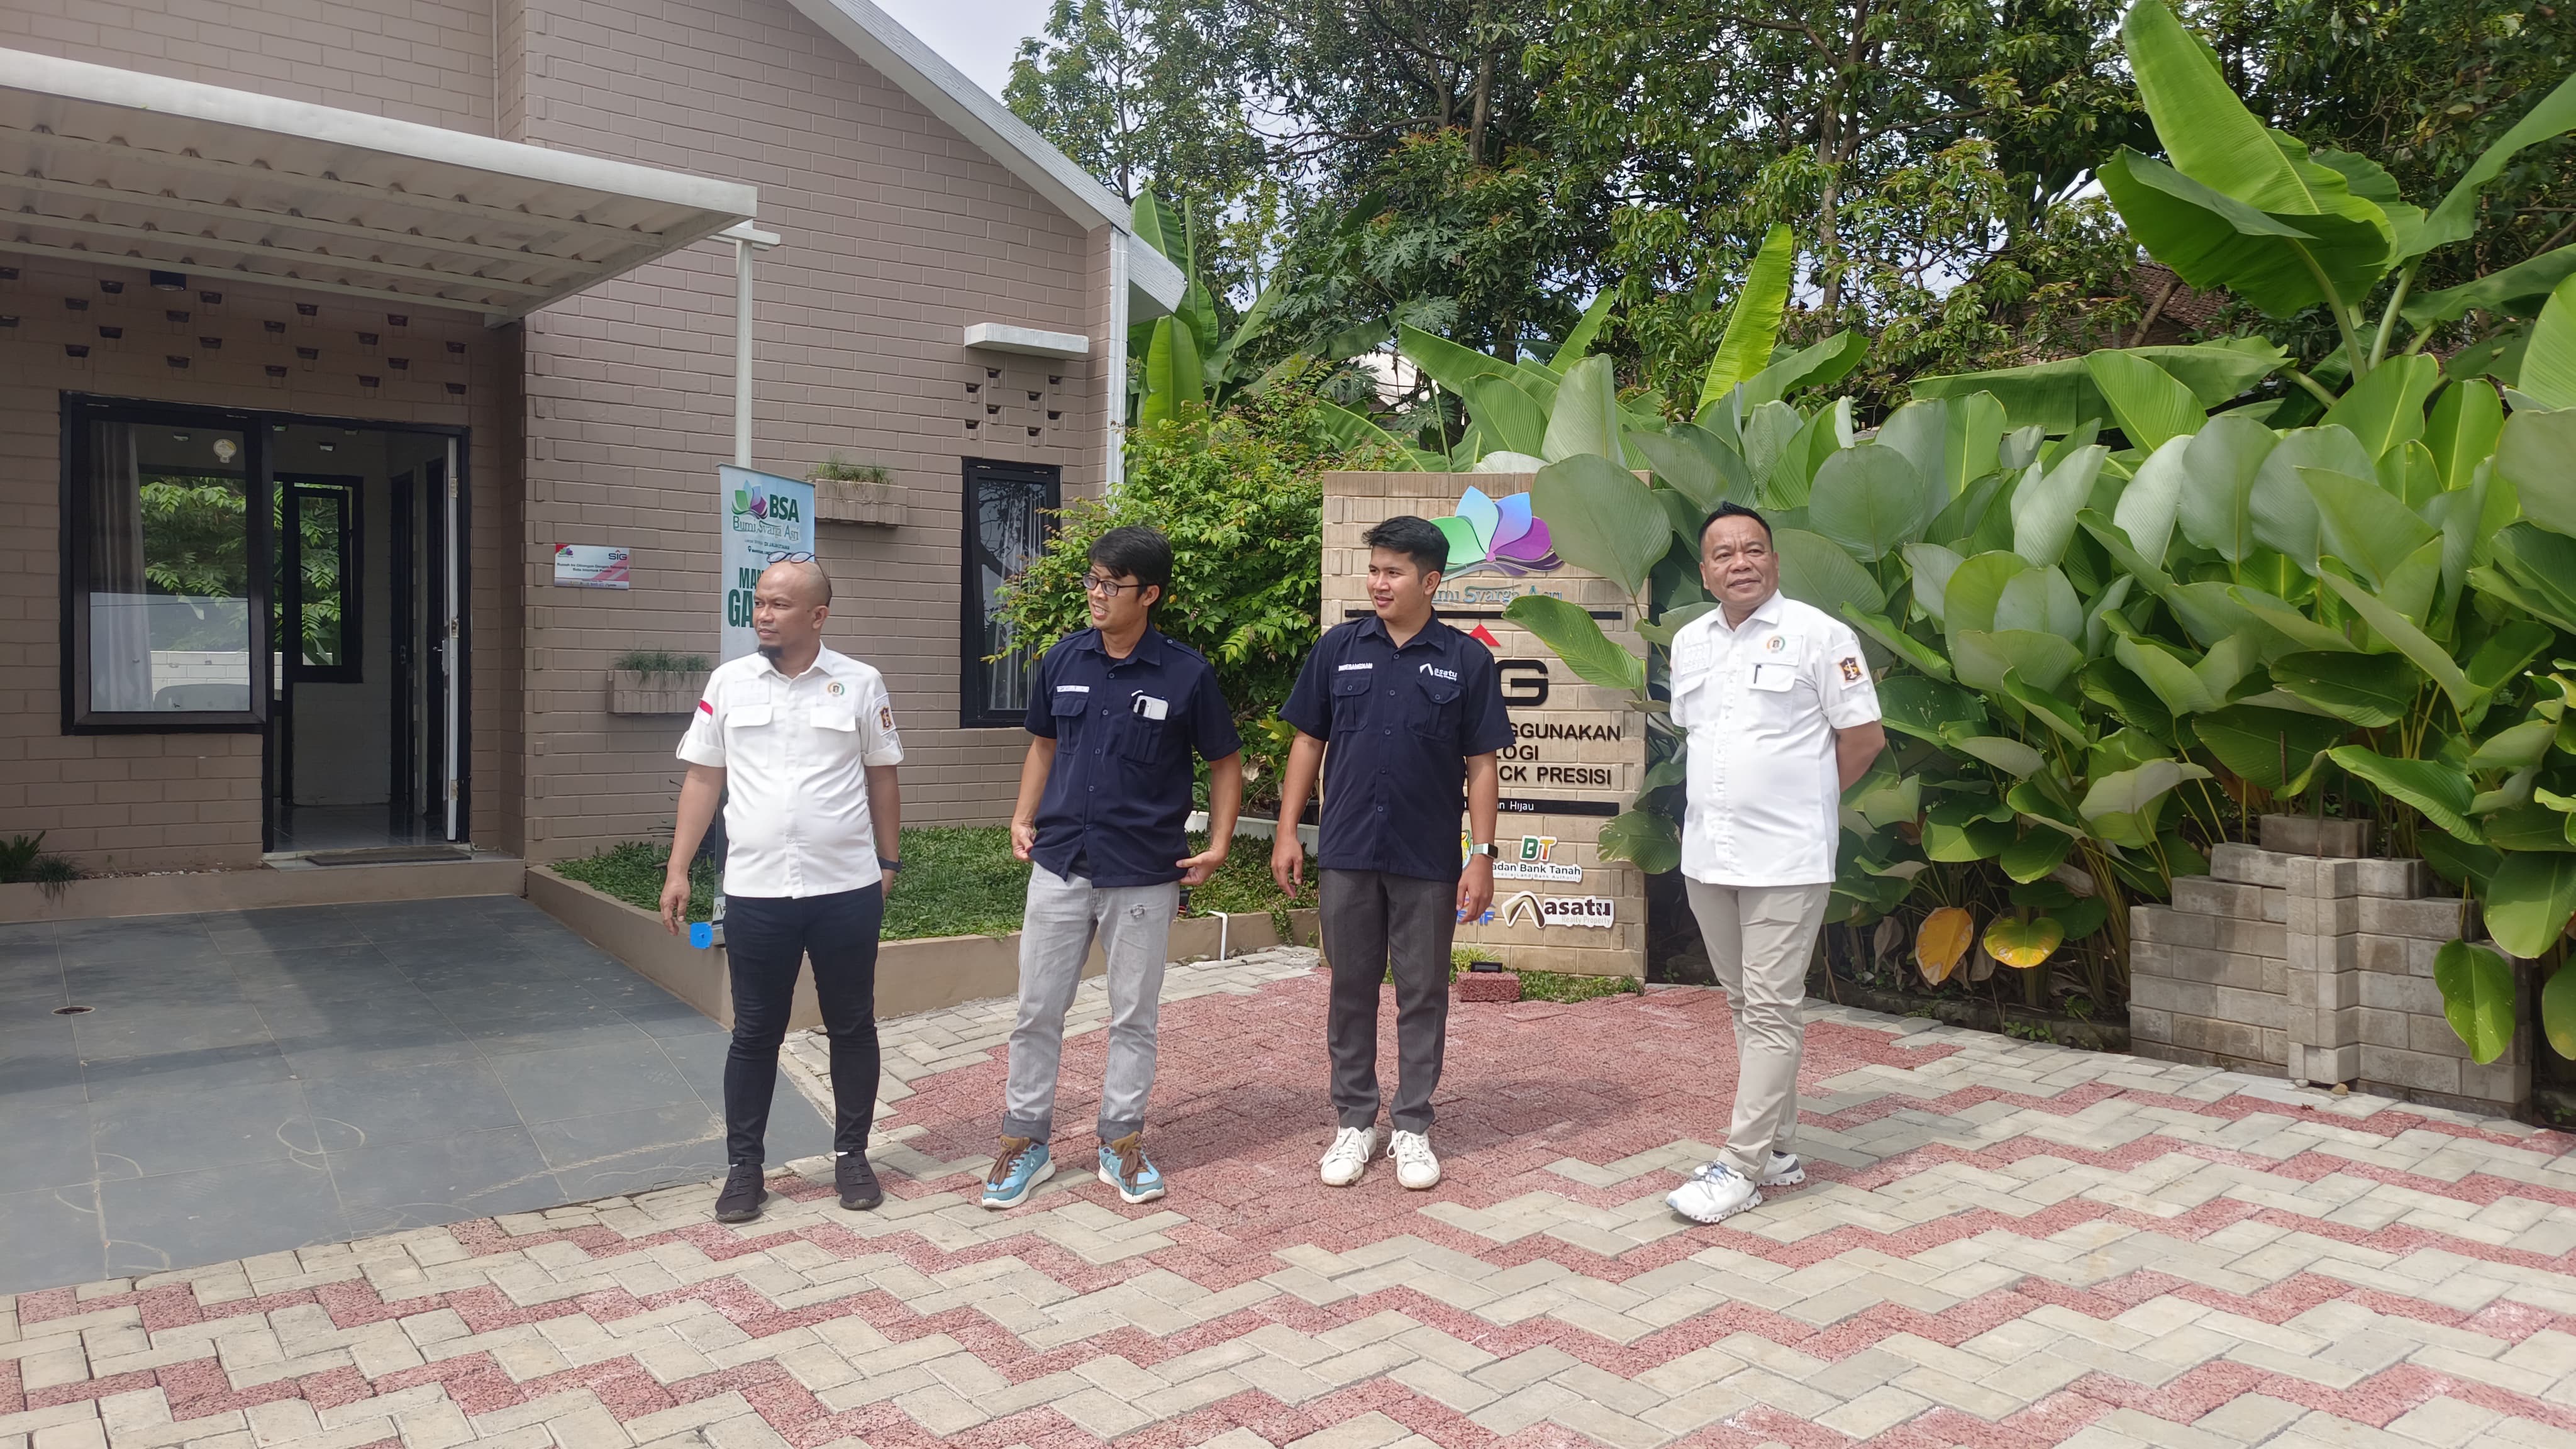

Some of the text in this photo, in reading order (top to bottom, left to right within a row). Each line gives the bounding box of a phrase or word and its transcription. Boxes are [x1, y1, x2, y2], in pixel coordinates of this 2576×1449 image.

[770, 494, 799, 523] BSA
[733, 516, 756, 532] Bumi
[728, 589, 755, 628] GA
[1435, 668, 1458, 678] asatu
[1495, 660, 1548, 706] G
[1509, 723, 1621, 741] GGUNAKAN
[1499, 765, 1611, 785] CK PRESISI
[1510, 801, 1535, 812] Hijau
[1522, 838, 1555, 860] BT
[1493, 863, 1580, 875] adan Bank Tanah
[1545, 899, 1610, 916] asatu
[1562, 916, 1611, 926] Realty Property
